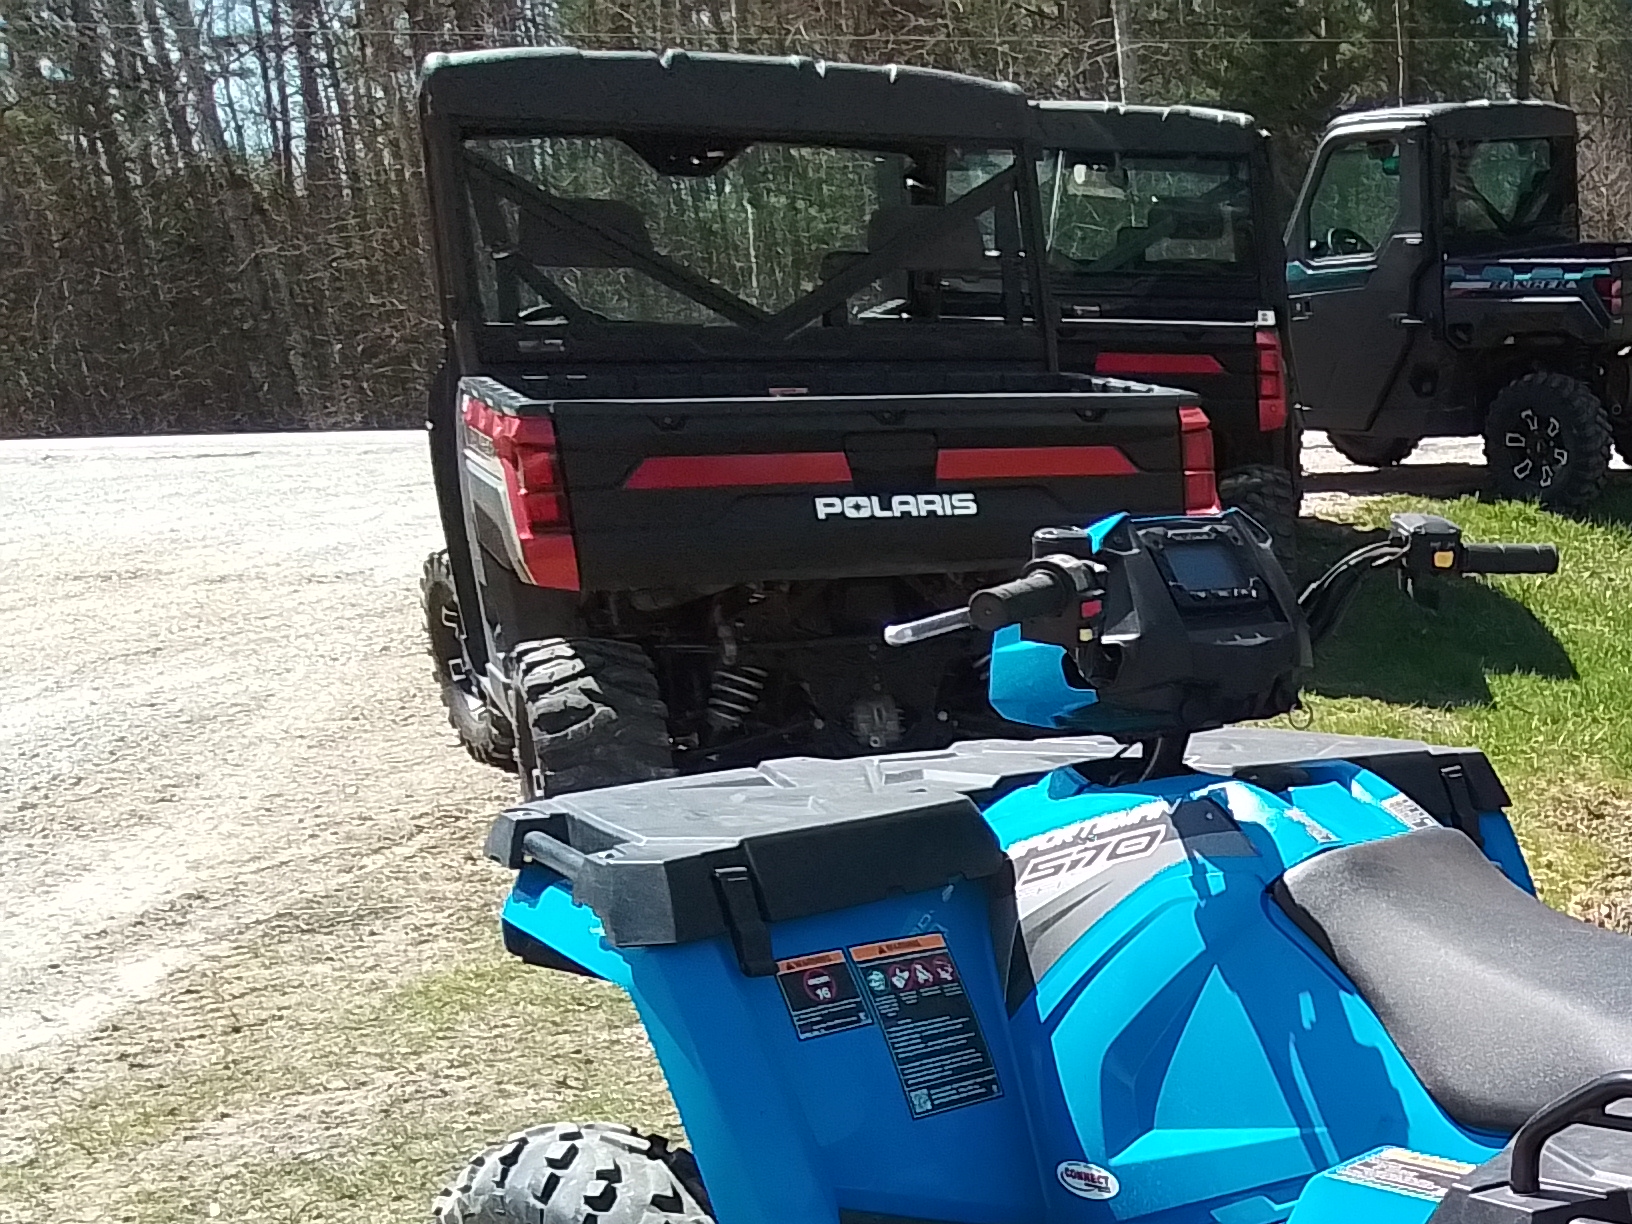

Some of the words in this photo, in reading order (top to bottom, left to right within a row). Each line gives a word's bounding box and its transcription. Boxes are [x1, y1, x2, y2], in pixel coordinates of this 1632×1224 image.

[814, 492, 978, 520] POLARIS
[1018, 823, 1167, 887] 570
[1064, 1166, 1110, 1187] CONNECT
